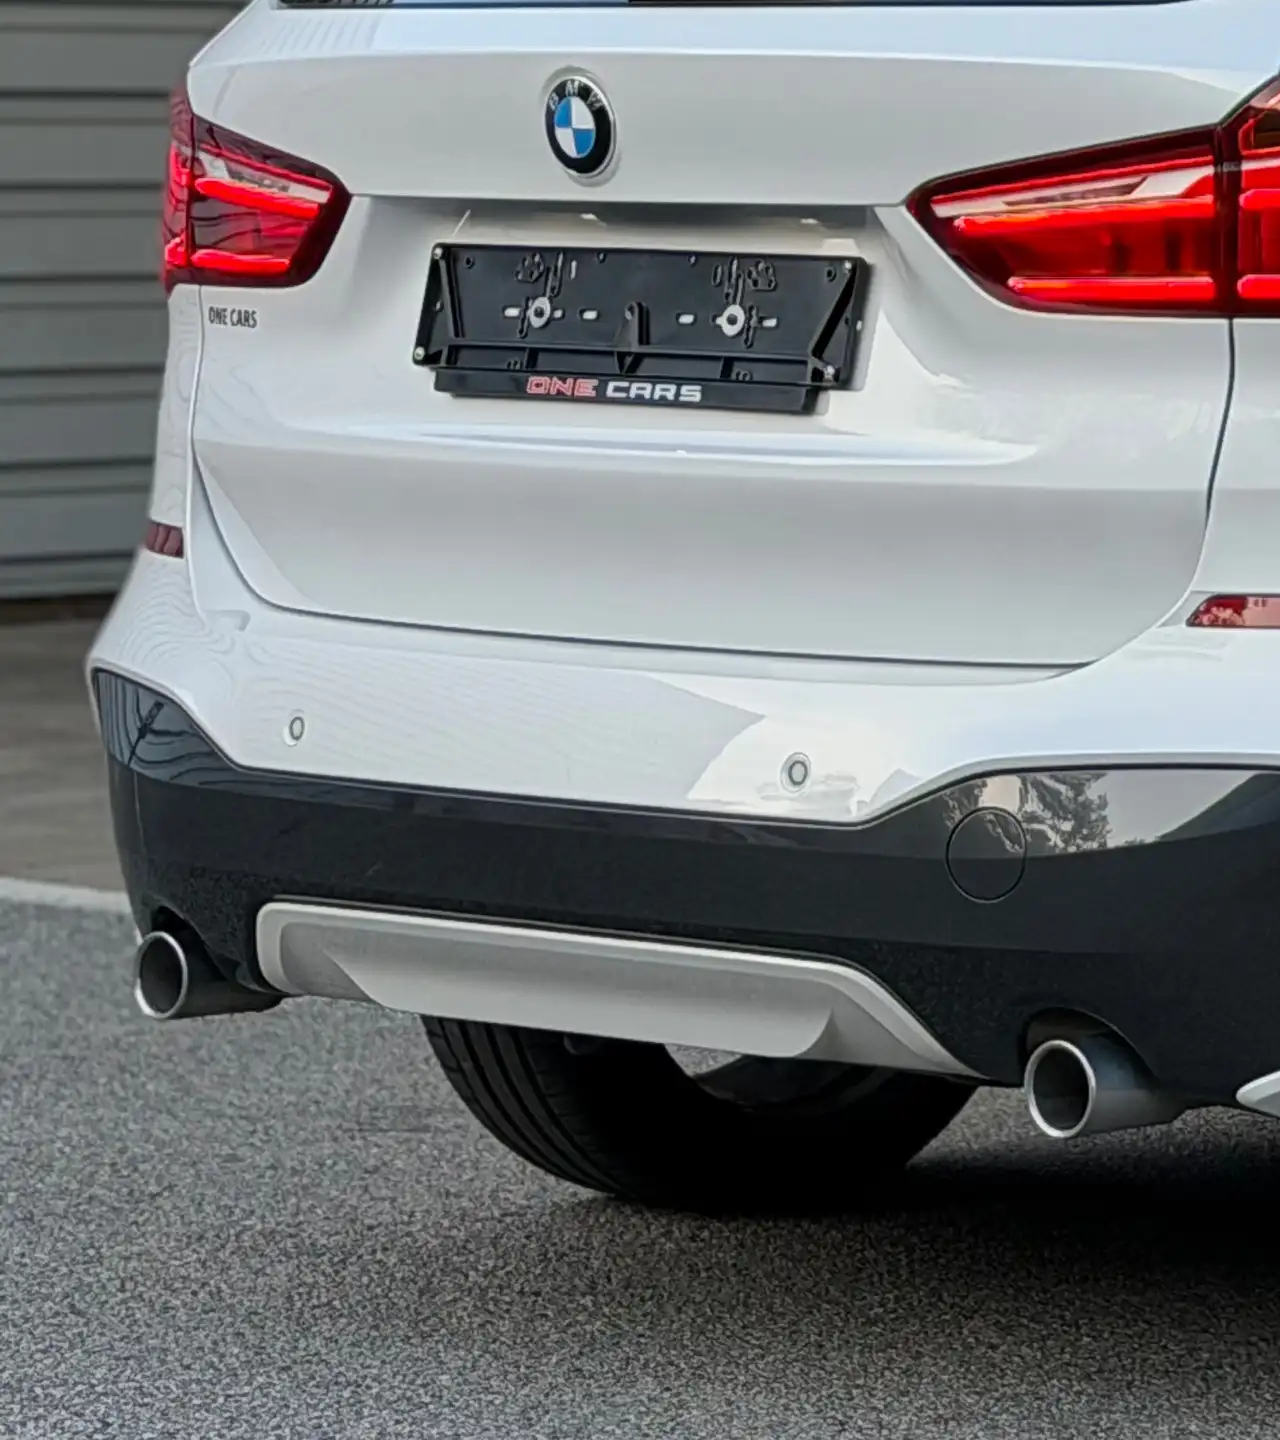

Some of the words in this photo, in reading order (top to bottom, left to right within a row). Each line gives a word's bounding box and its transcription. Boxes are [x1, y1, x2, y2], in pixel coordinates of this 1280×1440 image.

[208, 306, 228, 326] ONE
[229, 308, 258, 329] CARS
[526, 376, 599, 398] ONE
[605, 380, 702, 403] CARS
